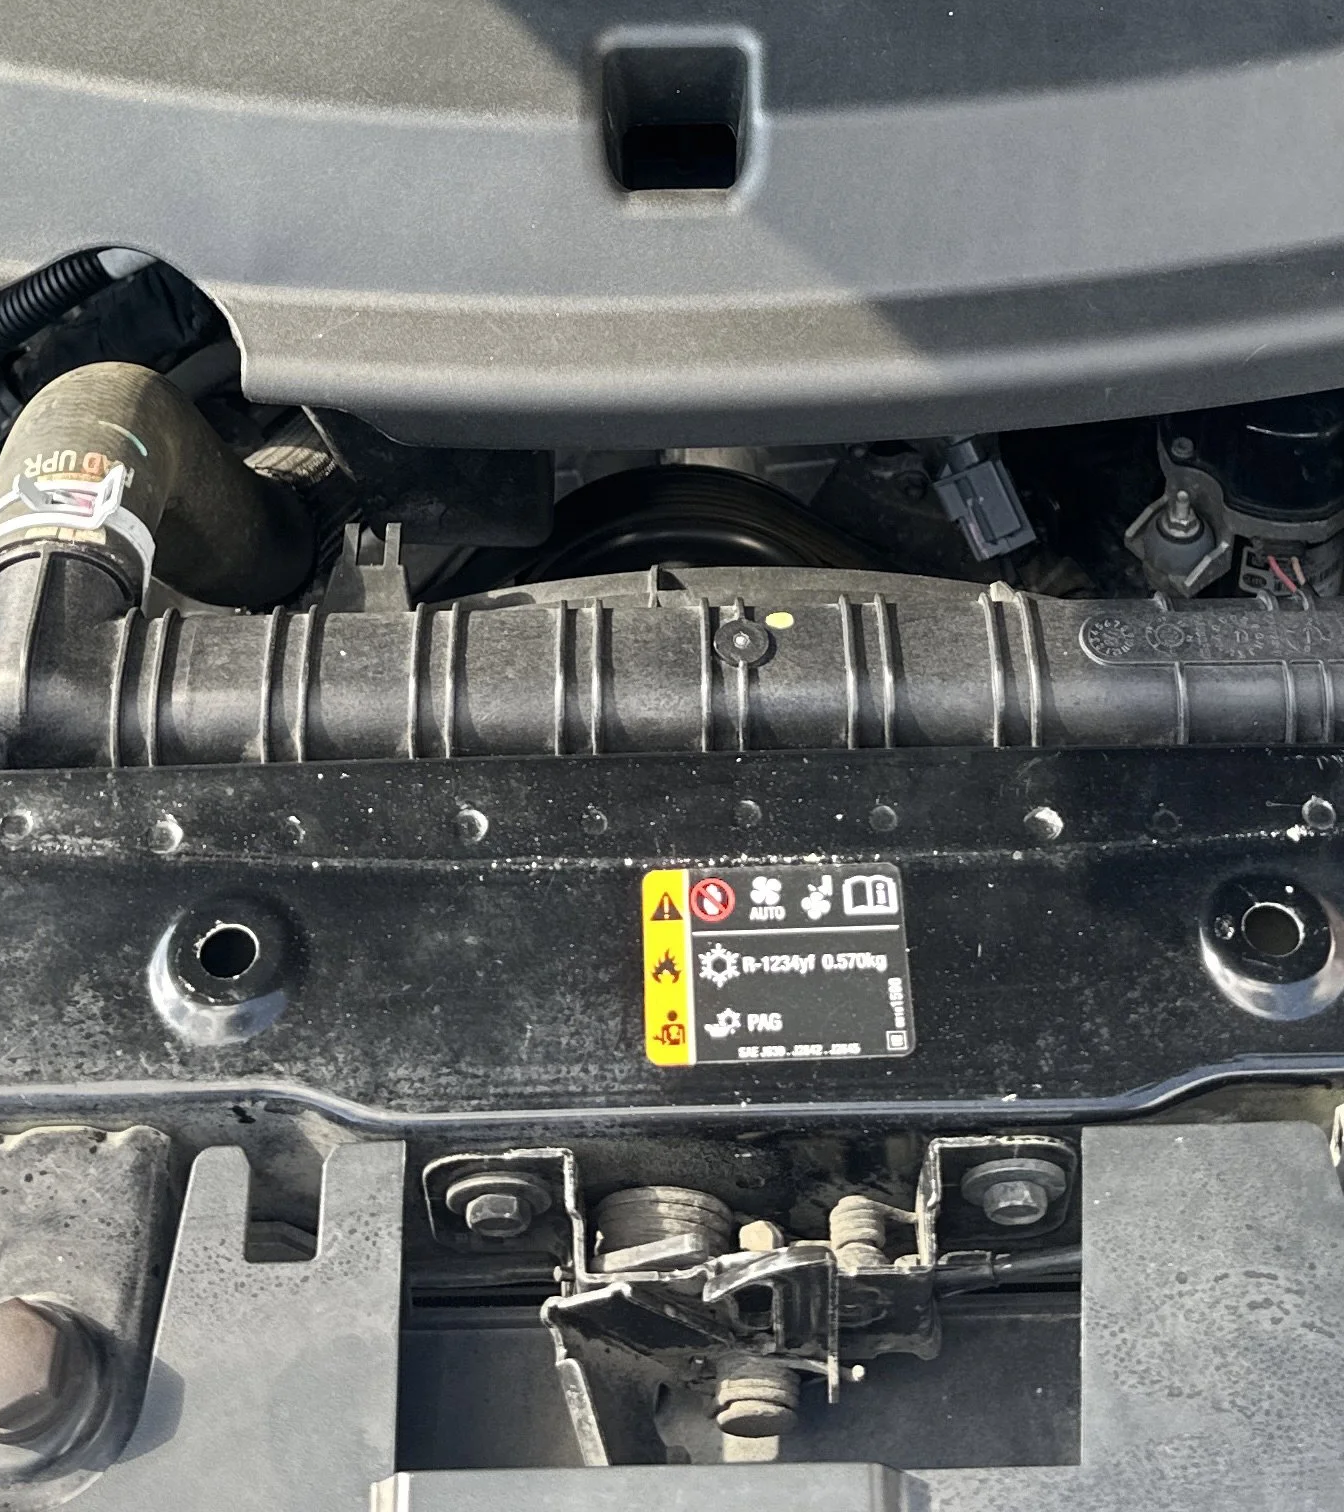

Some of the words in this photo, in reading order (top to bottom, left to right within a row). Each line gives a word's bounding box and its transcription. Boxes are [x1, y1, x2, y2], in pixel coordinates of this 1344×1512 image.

[23, 449, 77, 478] UPR
[749, 906, 786, 921] AUTO
[741, 953, 817, 975] R-1234yf
[746, 1012, 784, 1033] PAG
